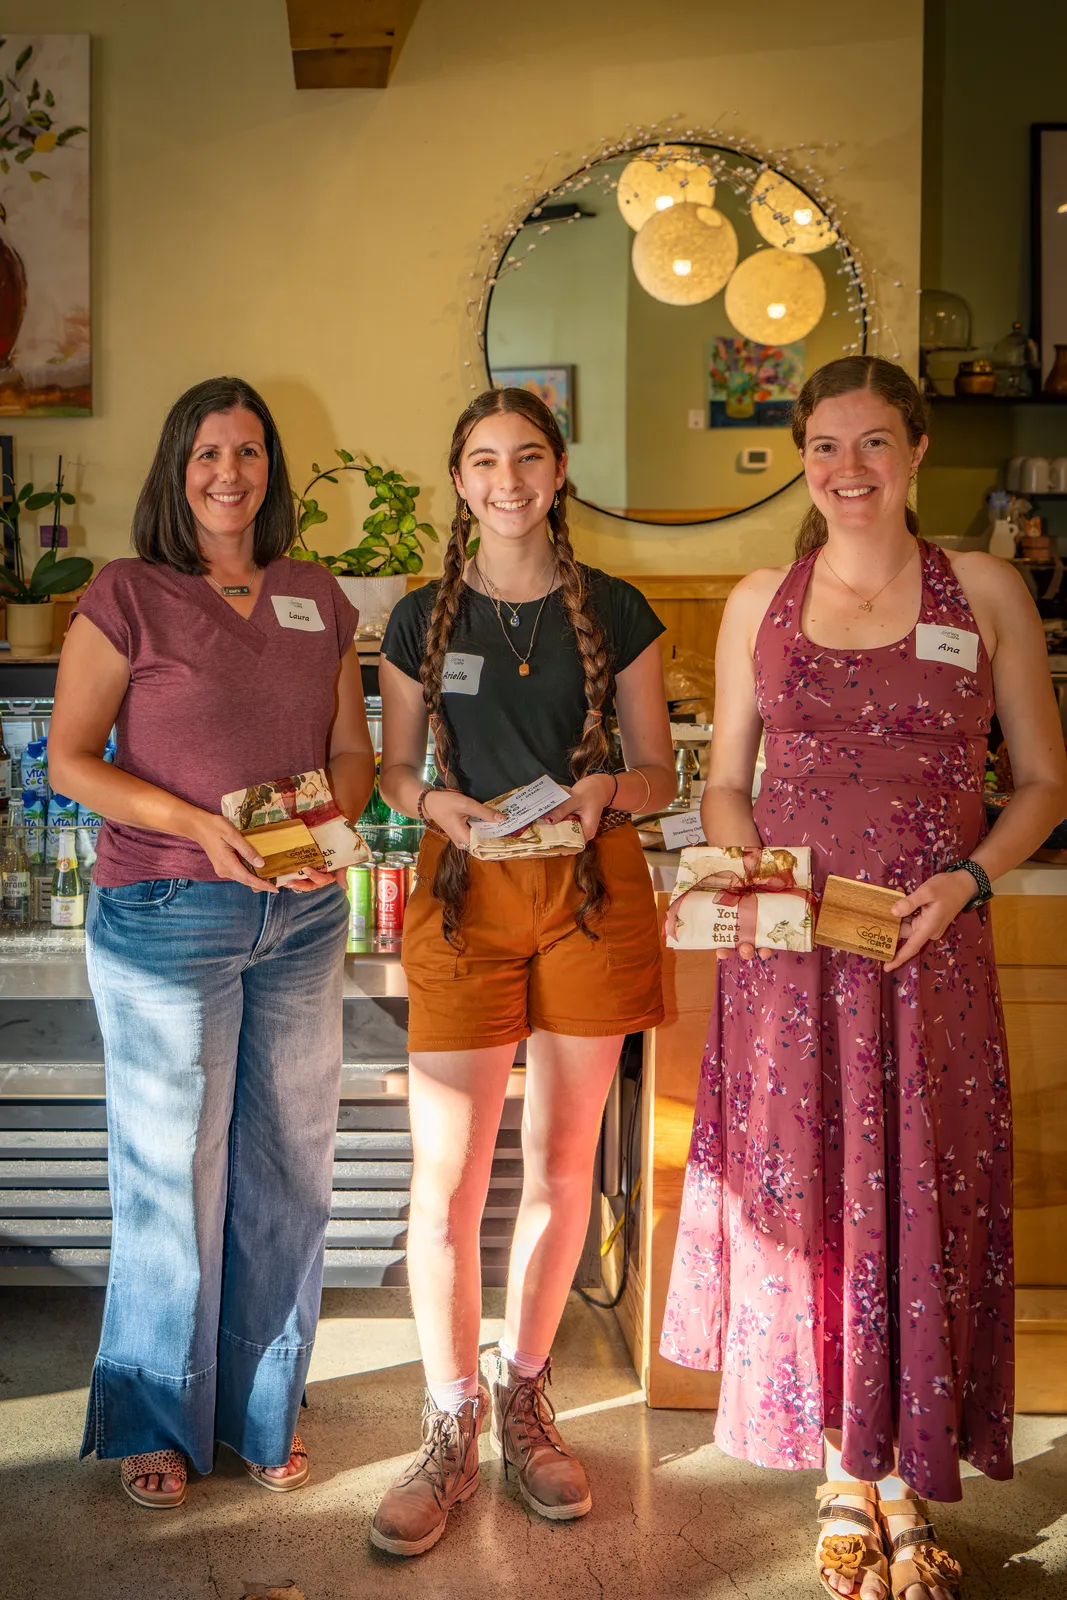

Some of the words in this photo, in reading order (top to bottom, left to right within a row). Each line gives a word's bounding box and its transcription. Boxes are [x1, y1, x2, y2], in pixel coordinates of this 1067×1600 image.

[289, 612, 310, 621] Laura
[938, 643, 961, 654] Ana
[443, 671, 468, 681] Arielle
[26, 769, 46, 778] VITA
[24, 818, 36, 827] ITA
[51, 817, 71, 827] VITA
[81, 817, 101, 827] VITA
[717, 909, 739, 920] You
[713, 923, 741, 932] goat
[712, 934, 740, 943] this
